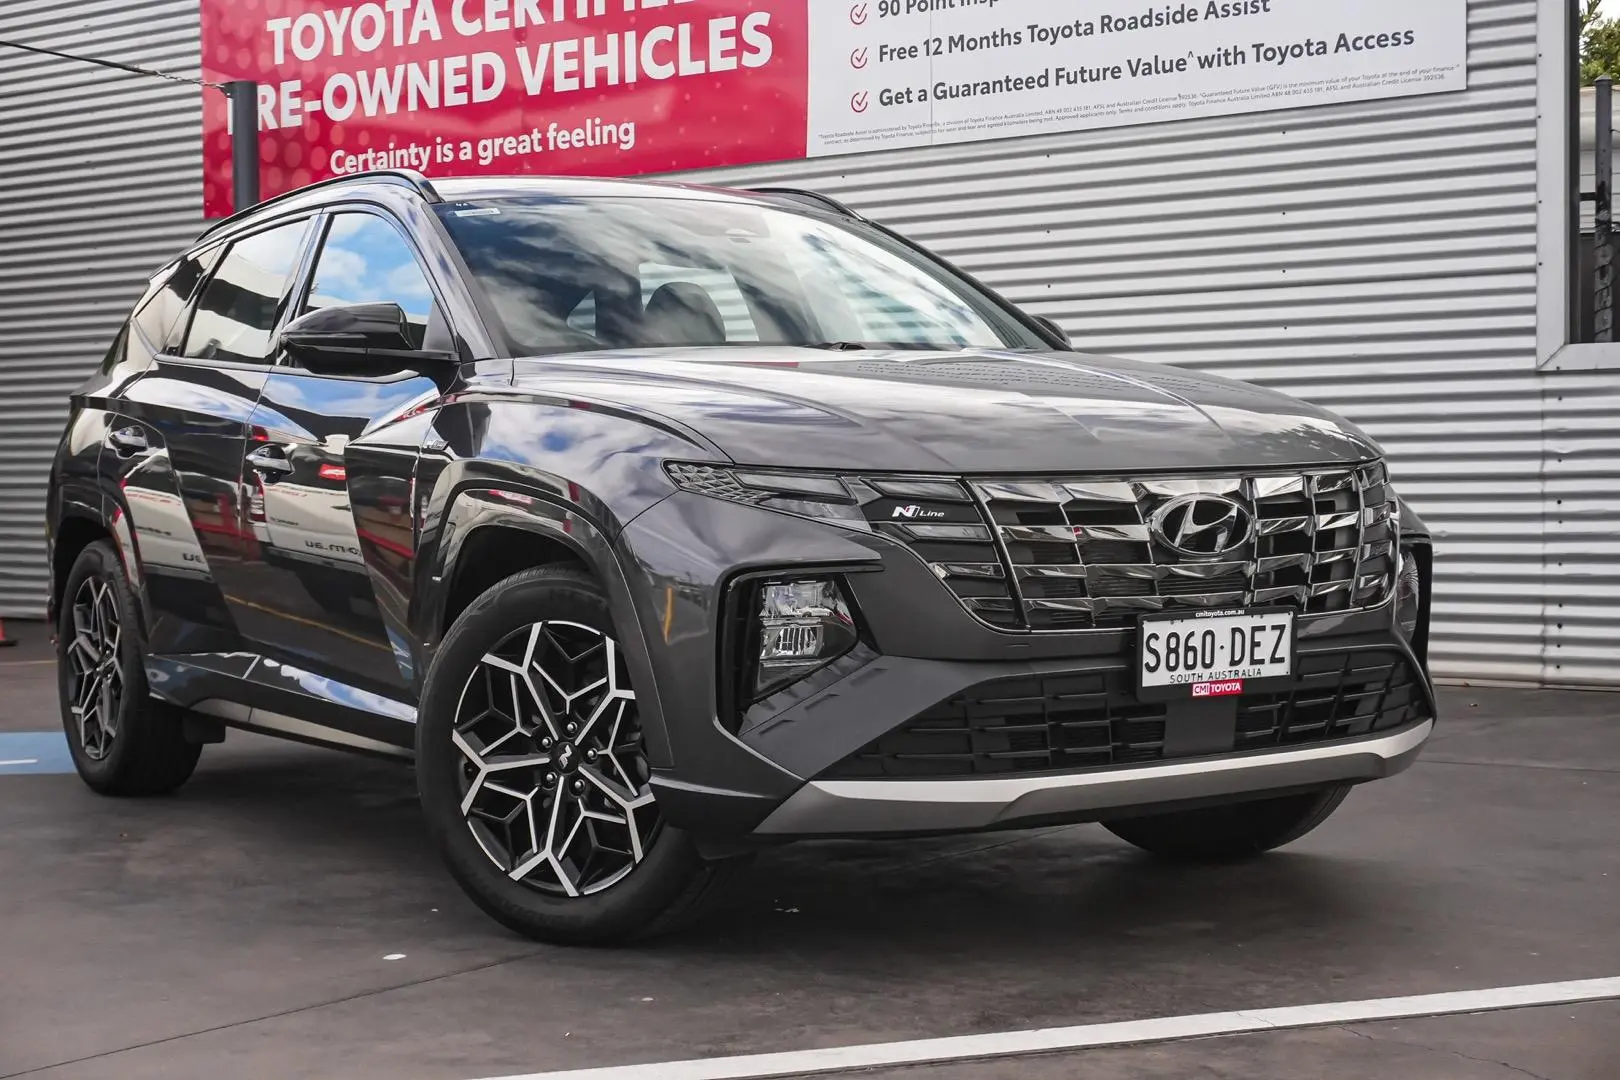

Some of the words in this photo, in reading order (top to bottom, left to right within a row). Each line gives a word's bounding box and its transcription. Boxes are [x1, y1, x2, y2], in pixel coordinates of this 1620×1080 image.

[266, 0, 443, 65] TOYOTA
[878, 0, 901, 18] 90
[879, 44, 919, 62] Free
[923, 37, 943, 56] 12
[948, 28, 1022, 53] Months
[1027, 20, 1094, 45] Toyota
[1100, 4, 1198, 34] Roadside
[1204, 0, 1271, 20] Assist
[227, 51, 507, 136] RE-OWNED
[514, 11, 773, 97] VEHICLES
[879, 87, 913, 106] Get
[917, 88, 928, 102] a
[933, 68, 1049, 100] Guaranteed
[1055, 65, 1122, 86] Future
[1197, 45, 1246, 69] with
[1252, 38, 1327, 65] Toyota
[1333, 30, 1415, 53] Access
[330, 142, 431, 175] Certainty
[435, 136, 454, 163] is
[458, 141, 473, 161] a
[477, 127, 542, 166] great
[546, 117, 636, 150] feeling
[1195, 609, 1245, 618] cmitoyota.com.au
[1169, 672, 1203, 684] SOUTH
[1208, 668, 1262, 680] AUSTRALIA
[1193, 683, 1210, 696] CMI
[1211, 682, 1241, 693] TOYOTA
